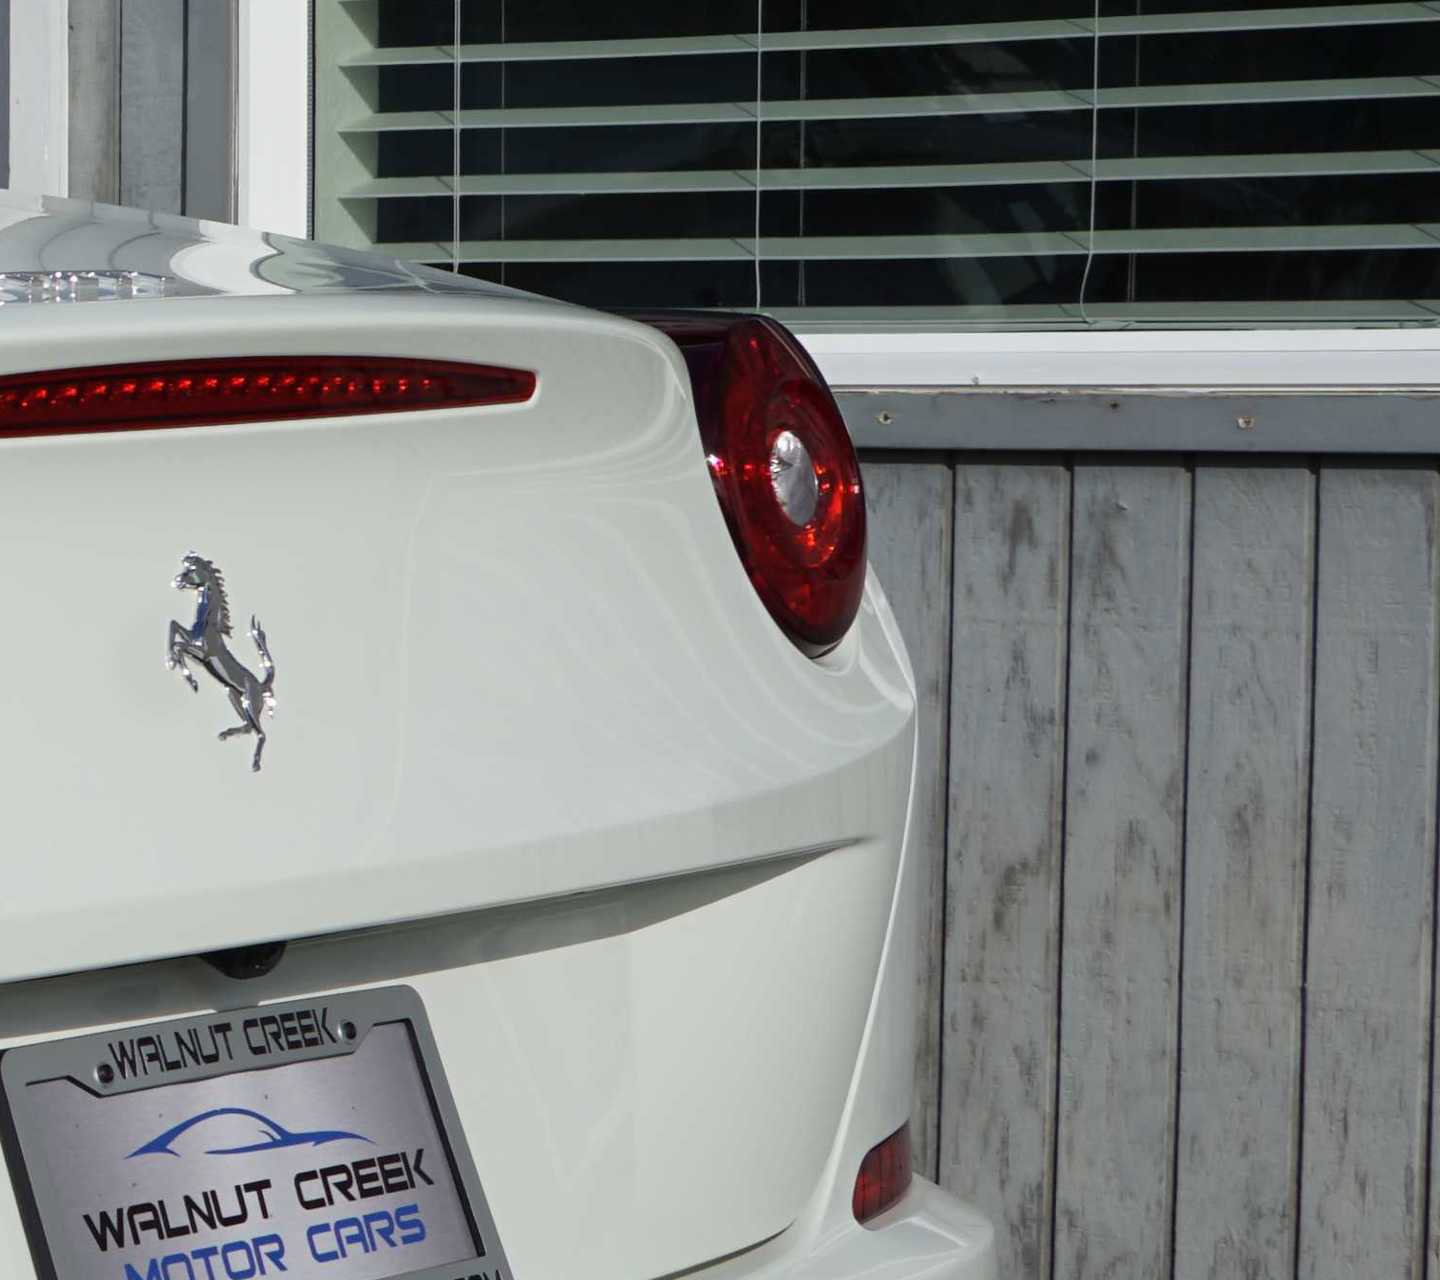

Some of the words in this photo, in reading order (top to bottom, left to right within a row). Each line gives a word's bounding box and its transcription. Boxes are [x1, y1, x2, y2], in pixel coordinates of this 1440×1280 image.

[108, 1021, 234, 1081] WALNUT
[243, 1007, 337, 1057] CREEK
[83, 1178, 273, 1252] WALNUT
[293, 1148, 435, 1211] CREEK
[305, 1203, 426, 1264] CARS
